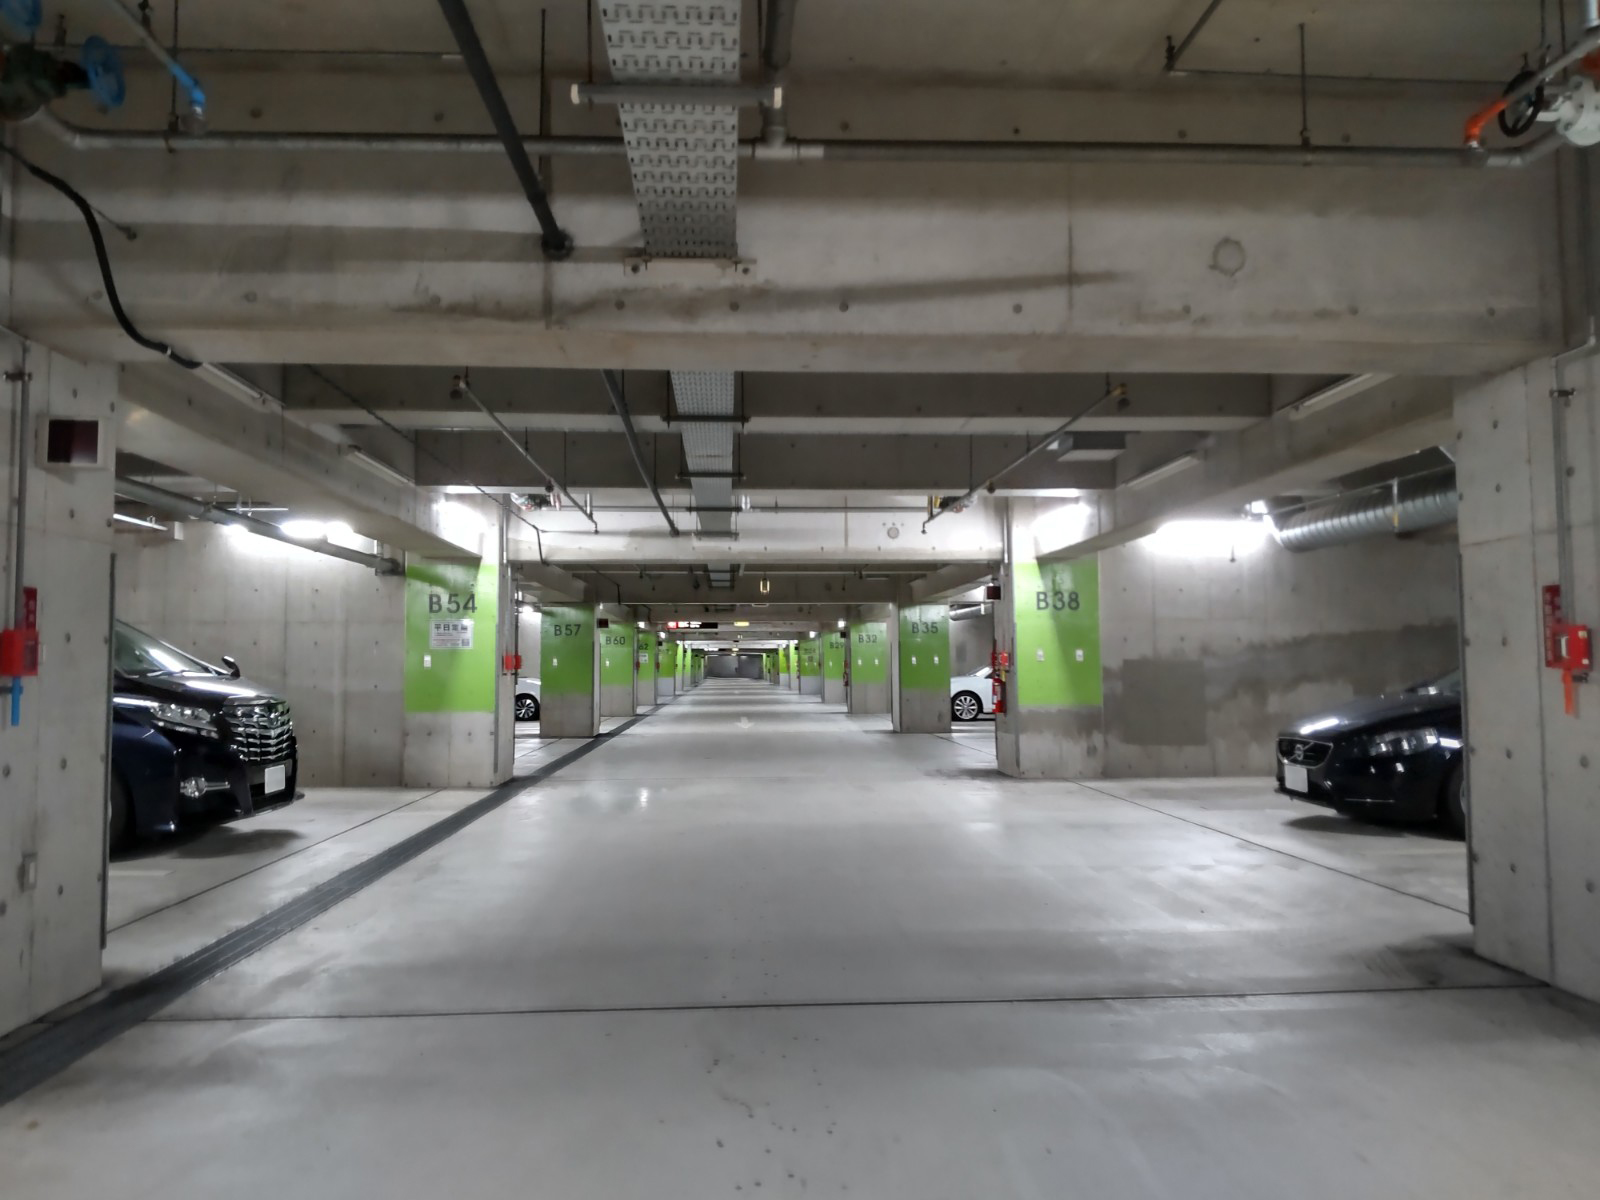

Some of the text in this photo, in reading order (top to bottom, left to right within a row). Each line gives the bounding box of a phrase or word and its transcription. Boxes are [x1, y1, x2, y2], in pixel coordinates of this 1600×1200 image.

[429, 592, 477, 613] B54
[1036, 591, 1080, 610] B38
[554, 624, 581, 636] B57
[911, 622, 938, 634] B35
[605, 636, 625, 645] B60
[858, 634, 877, 643] B32
